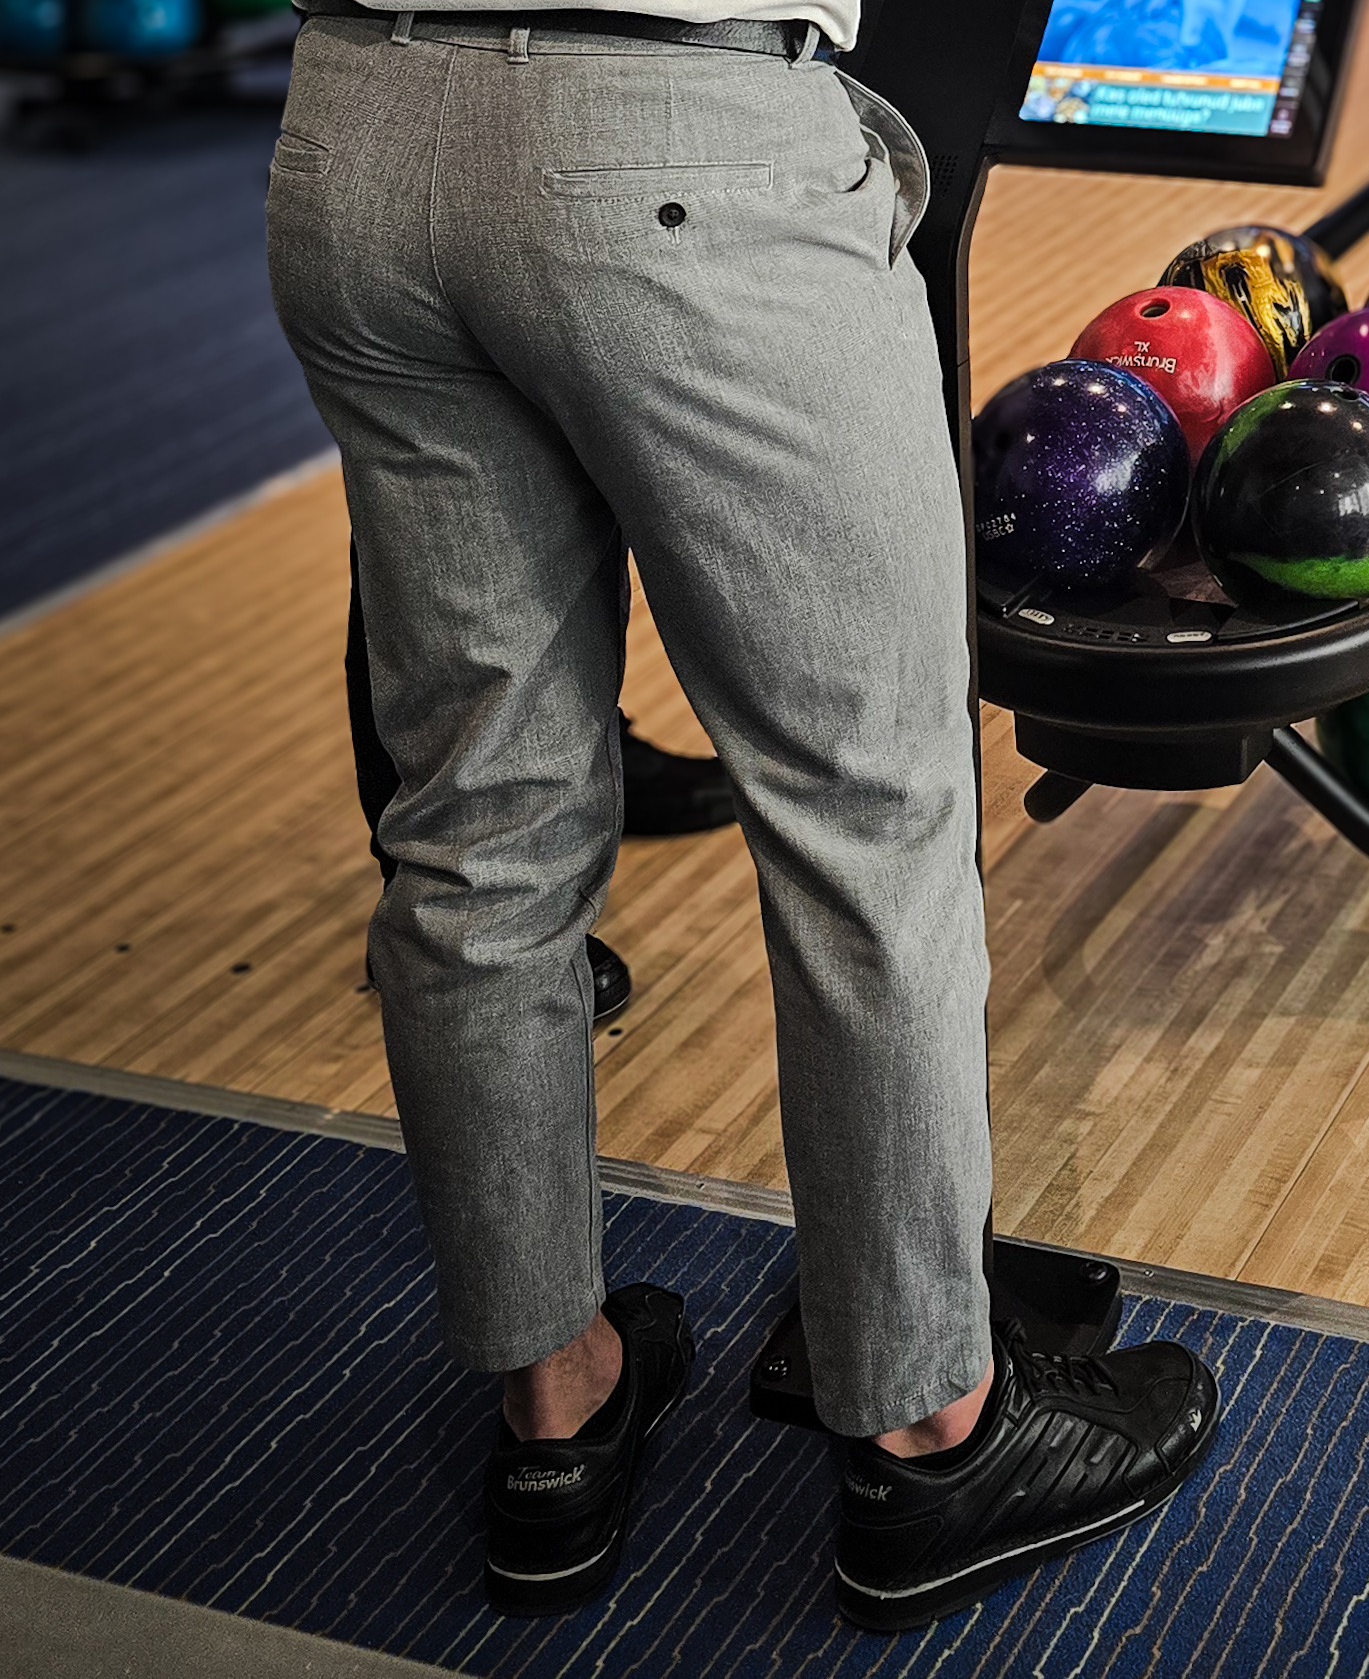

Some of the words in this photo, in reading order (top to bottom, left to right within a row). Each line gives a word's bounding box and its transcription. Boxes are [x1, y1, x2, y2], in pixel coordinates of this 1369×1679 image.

[1134, 341, 1150, 352] XL
[507, 1464, 585, 1492] Brunswick
[518, 1466, 557, 1479] Team
